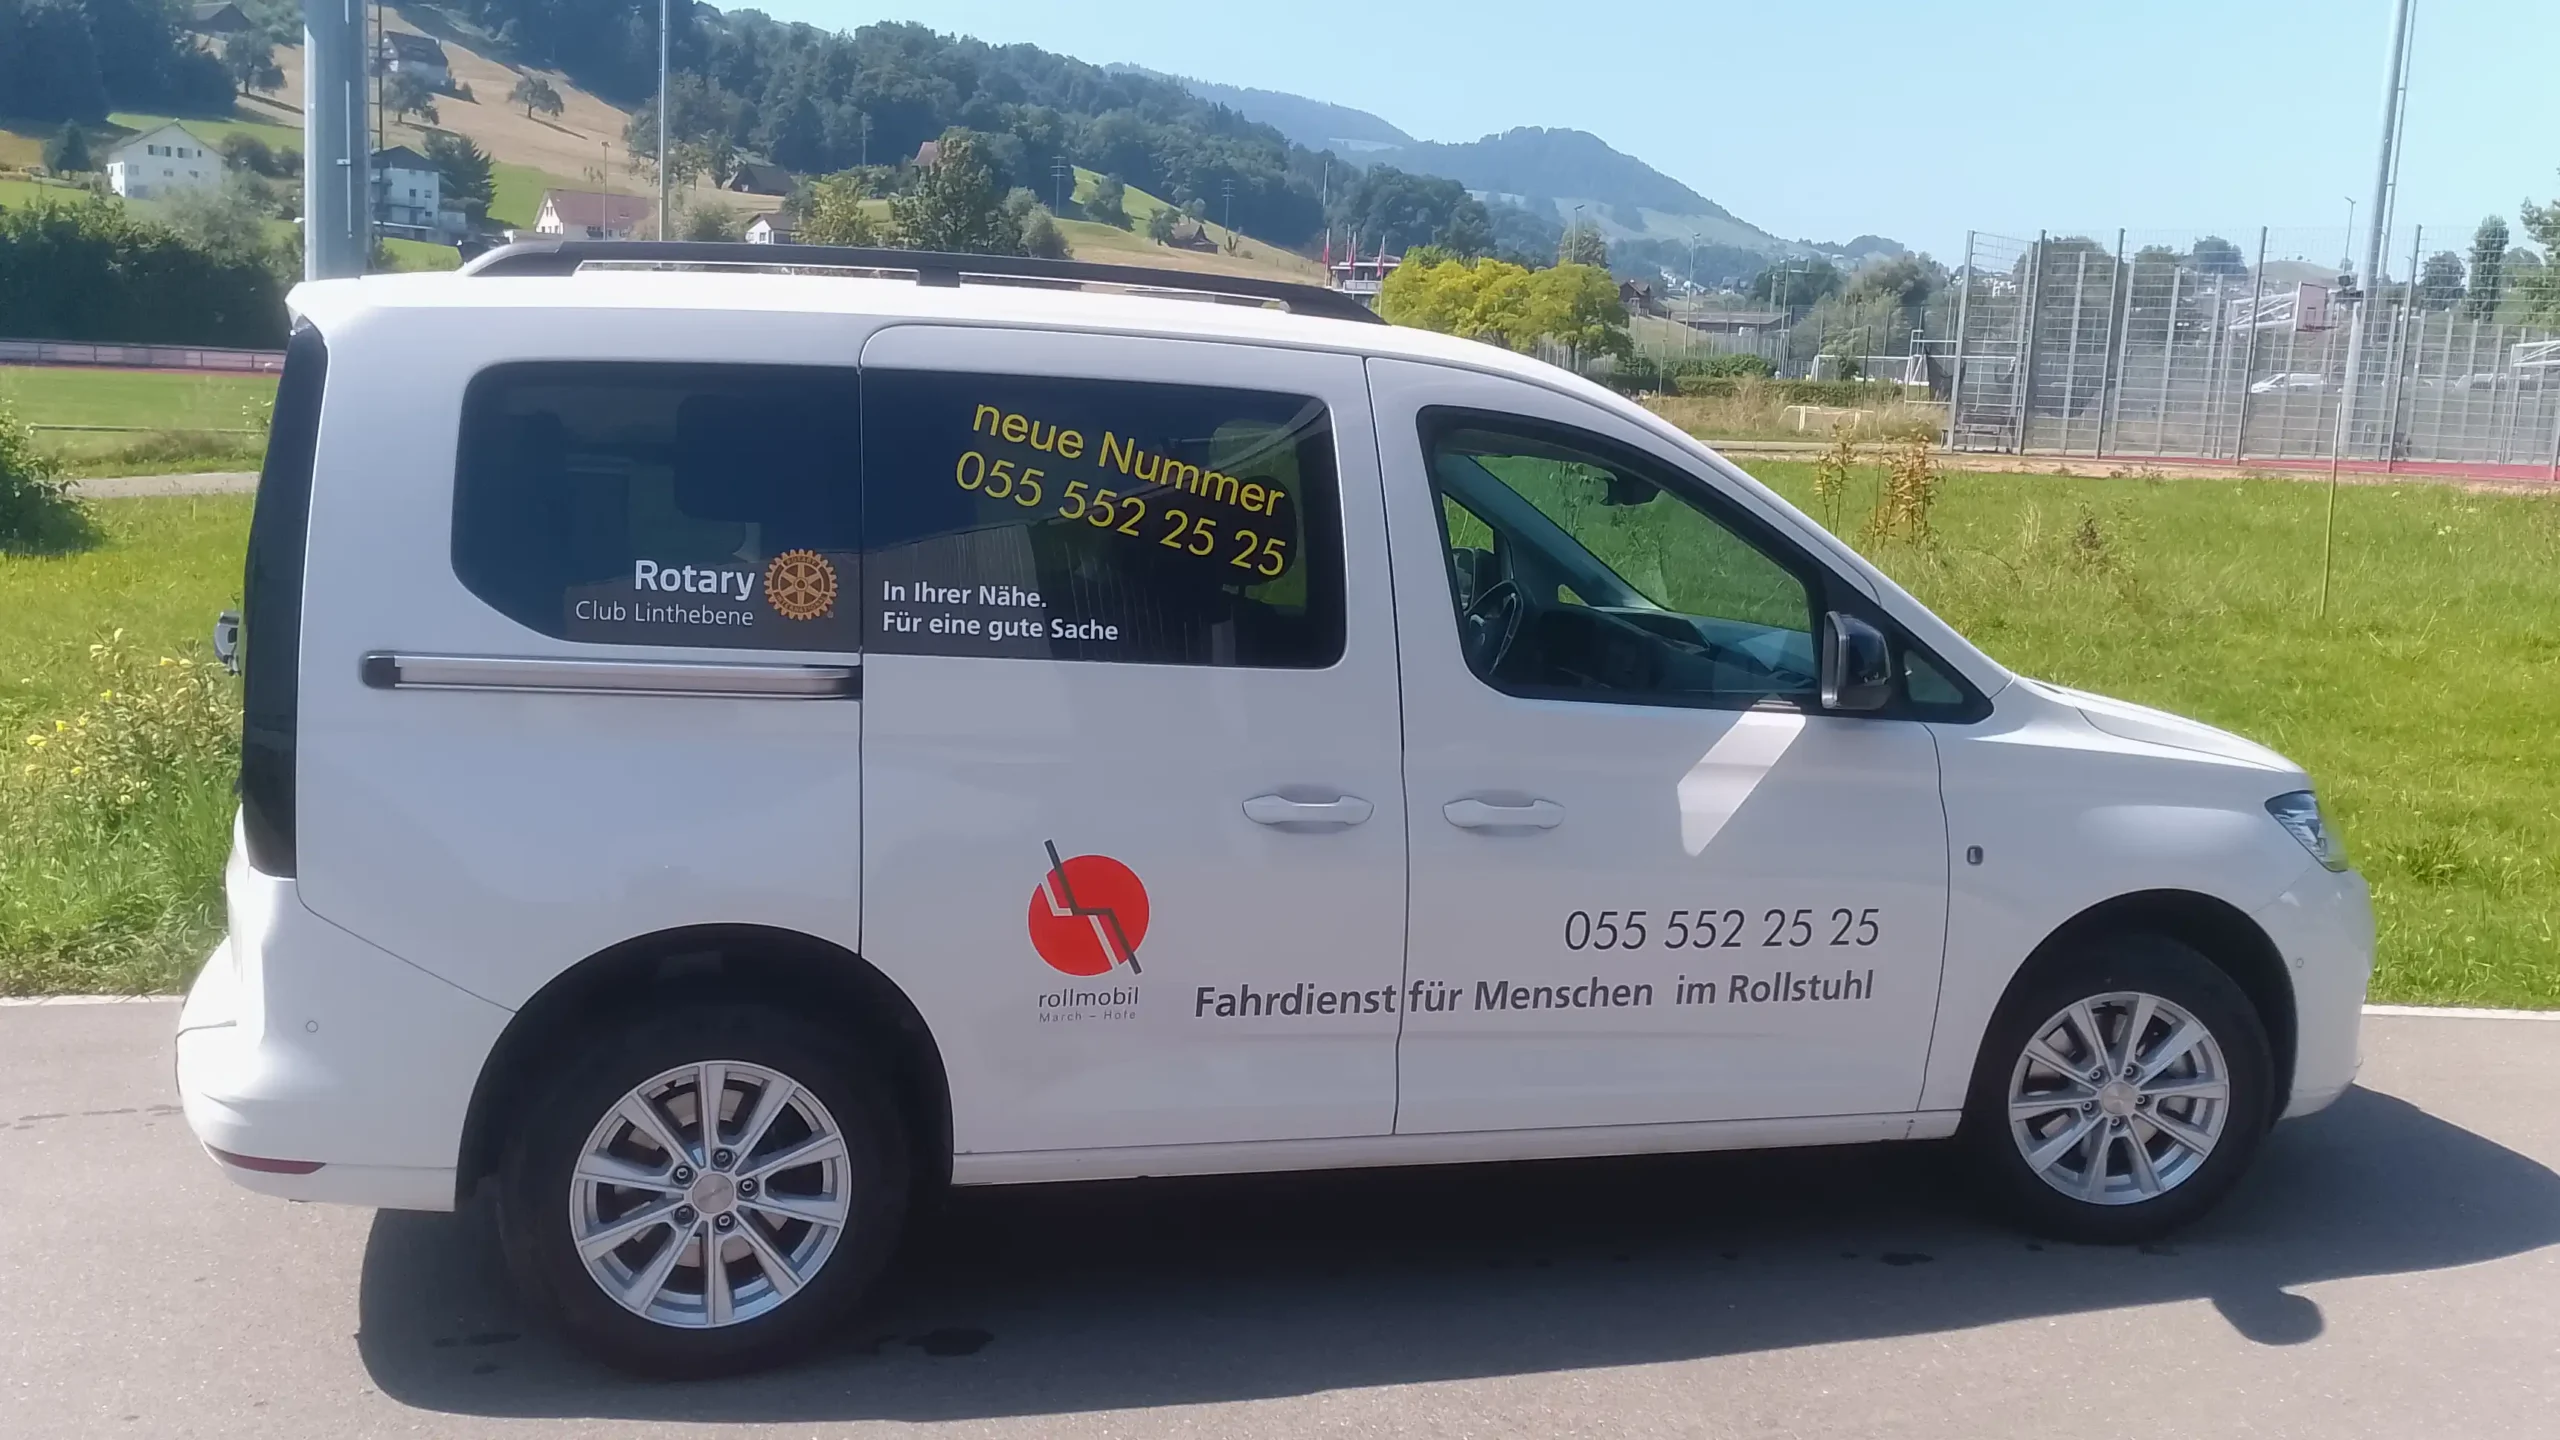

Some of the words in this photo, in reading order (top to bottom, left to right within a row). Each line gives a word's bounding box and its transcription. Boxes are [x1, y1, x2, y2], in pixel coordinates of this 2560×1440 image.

[972, 403, 1084, 459] neue
[1098, 431, 1285, 516] Nummer
[956, 451, 1045, 507] 055
[1058, 480, 1146, 537] 552
[1159, 509, 1217, 556] 25
[1230, 529, 1287, 576] 25
[634, 559, 756, 601] Rotary
[883, 580, 906, 602] In
[914, 581, 972, 604] Ihrer
[978, 585, 1048, 608] Nähe.
[575, 600, 627, 621] Club
[635, 602, 754, 626] Linthebene
[883, 611, 923, 633] Für
[929, 613, 981, 635] eine
[988, 618, 1044, 641] gute
[1050, 618, 1119, 641] Sache
[1564, 910, 1648, 951] 055
[1663, 909, 1745, 949] 552
[1761, 908, 1813, 947] 25
[1829, 908, 1880, 946] 25
[1039, 986, 1139, 1008] rollmobil
[1194, 983, 1398, 1018] Fahrdienst
[1408, 979, 1463, 1013] für
[1474, 976, 1653, 1011] Menschen
[1675, 974, 1717, 1005] im
[1728, 969, 1874, 1004] Rollstuhl
[1039, 1011, 1082, 1023] March
